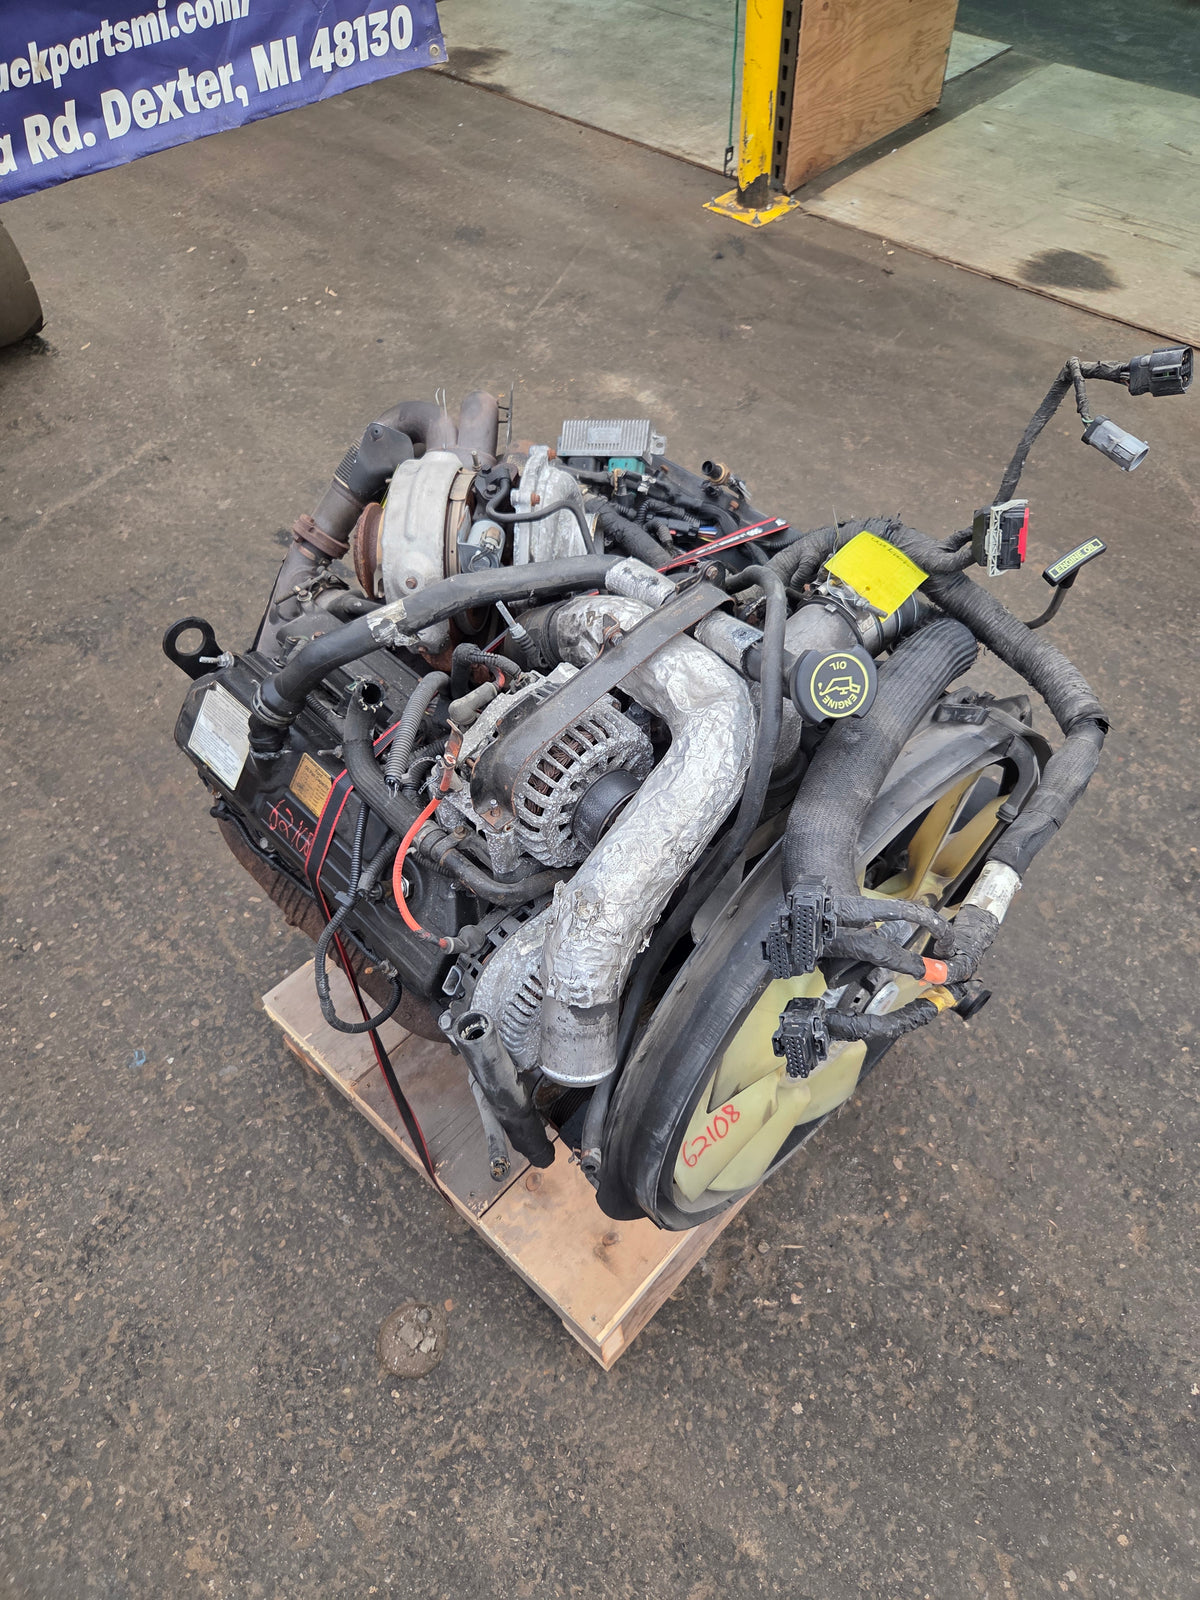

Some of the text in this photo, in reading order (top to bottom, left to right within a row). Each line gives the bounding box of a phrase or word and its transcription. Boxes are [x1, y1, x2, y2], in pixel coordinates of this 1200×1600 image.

[23, 99, 97, 165] Rd.
[100, 62, 249, 140] Dexter,
[250, 35, 302, 93] MI
[309, 4, 413, 73] 48130
[1056, 550, 1085, 574] ENGINE
[829, 660, 847, 671] OIL
[821, 693, 858, 710] ENGINE
[682, 1104, 741, 1168] 62108
